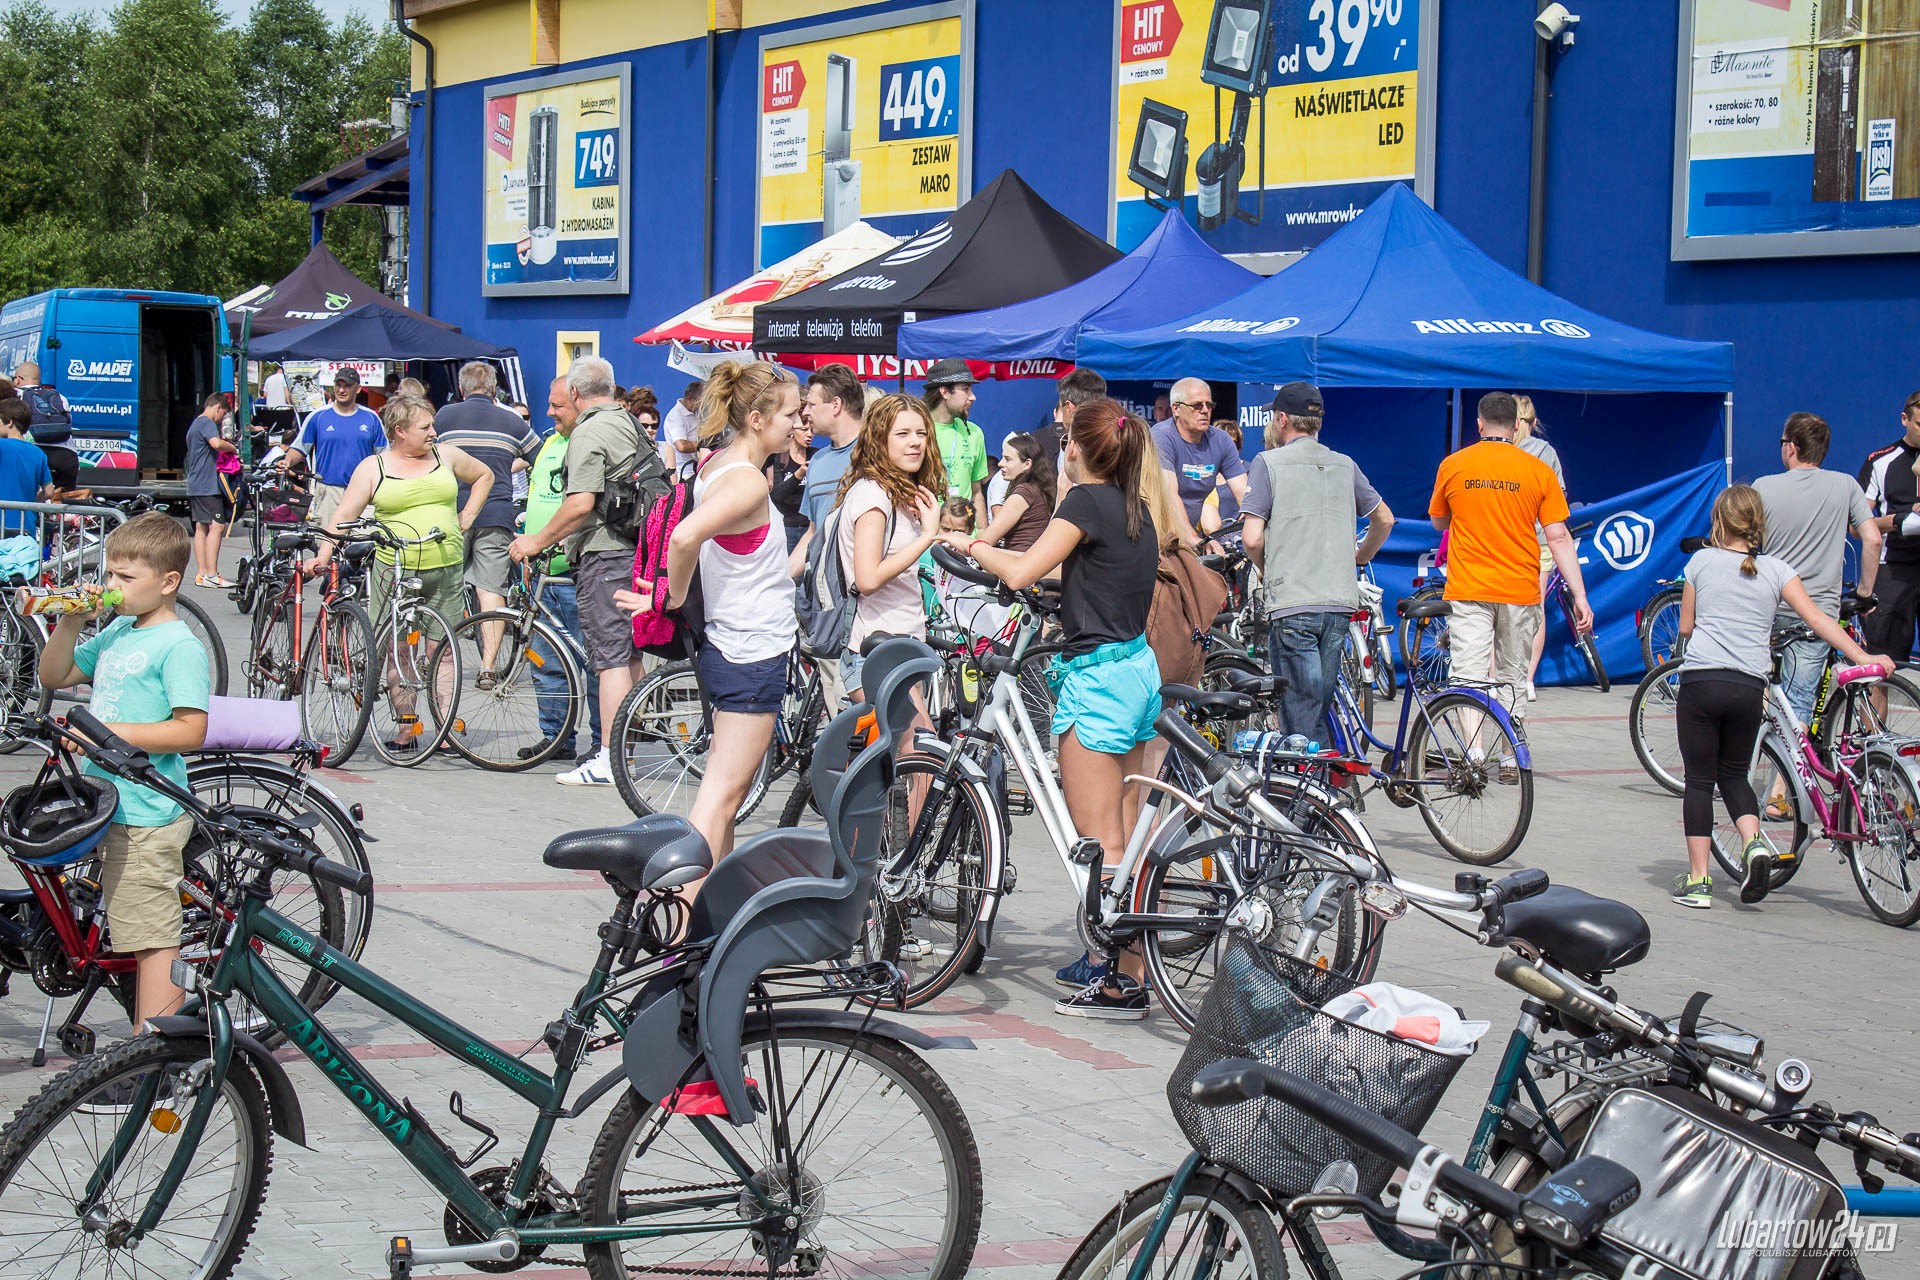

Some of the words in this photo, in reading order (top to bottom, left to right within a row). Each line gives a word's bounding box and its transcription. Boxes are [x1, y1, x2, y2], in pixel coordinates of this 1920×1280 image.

[1133, 5, 1165, 41] HIT
[1132, 39, 1163, 56] CENOWY
[1278, 44, 1299, 74] od
[1718, 53, 1774, 73] Masonite
[772, 65, 794, 95] HIT
[1150, 67, 1164, 76] moce
[771, 94, 794, 107] CENOWY
[1295, 85, 1404, 118] NAŚWIETLACZE
[1715, 98, 1753, 111] szerokość:
[1754, 98, 1766, 109] 70,
[1768, 96, 1778, 107] 80
[1714, 116, 1735, 126] różne
[1736, 113, 1760, 126] kolory
[493, 130, 513, 151] cenowy
[1379, 122, 1404, 146] LED
[912, 144, 952, 165] ZESTAW
[1872, 141, 1891, 173] psb
[920, 173, 950, 194] MARO
[592, 197, 614, 210] KABINA
[561, 222, 566, 232] Z
[566, 215, 614, 232] HYDROMASAŻEM
[563, 251, 615, 267] www.mrowka.com.pl
[768, 320, 800, 338] internet
[806, 318, 844, 341] telewizja
[851, 318, 882, 337] telefon
[1176, 318, 1264, 333] Allianz
[1411, 318, 1543, 334] Allianz
[88, 361, 133, 376] MAPEI
[857, 355, 944, 377] TYSKI
[1239, 405, 1275, 427] Allia
[94, 440, 120, 449] 26104
[1464, 479, 1521, 493] ORGANIZATOR
[468, 1040, 531, 1082] SHIMANO
[288, 1018, 412, 1144] ARIZONA
[1155, 1191, 1173, 1220] Allegro
[1608, 1186, 1638, 1213] CATEYE
